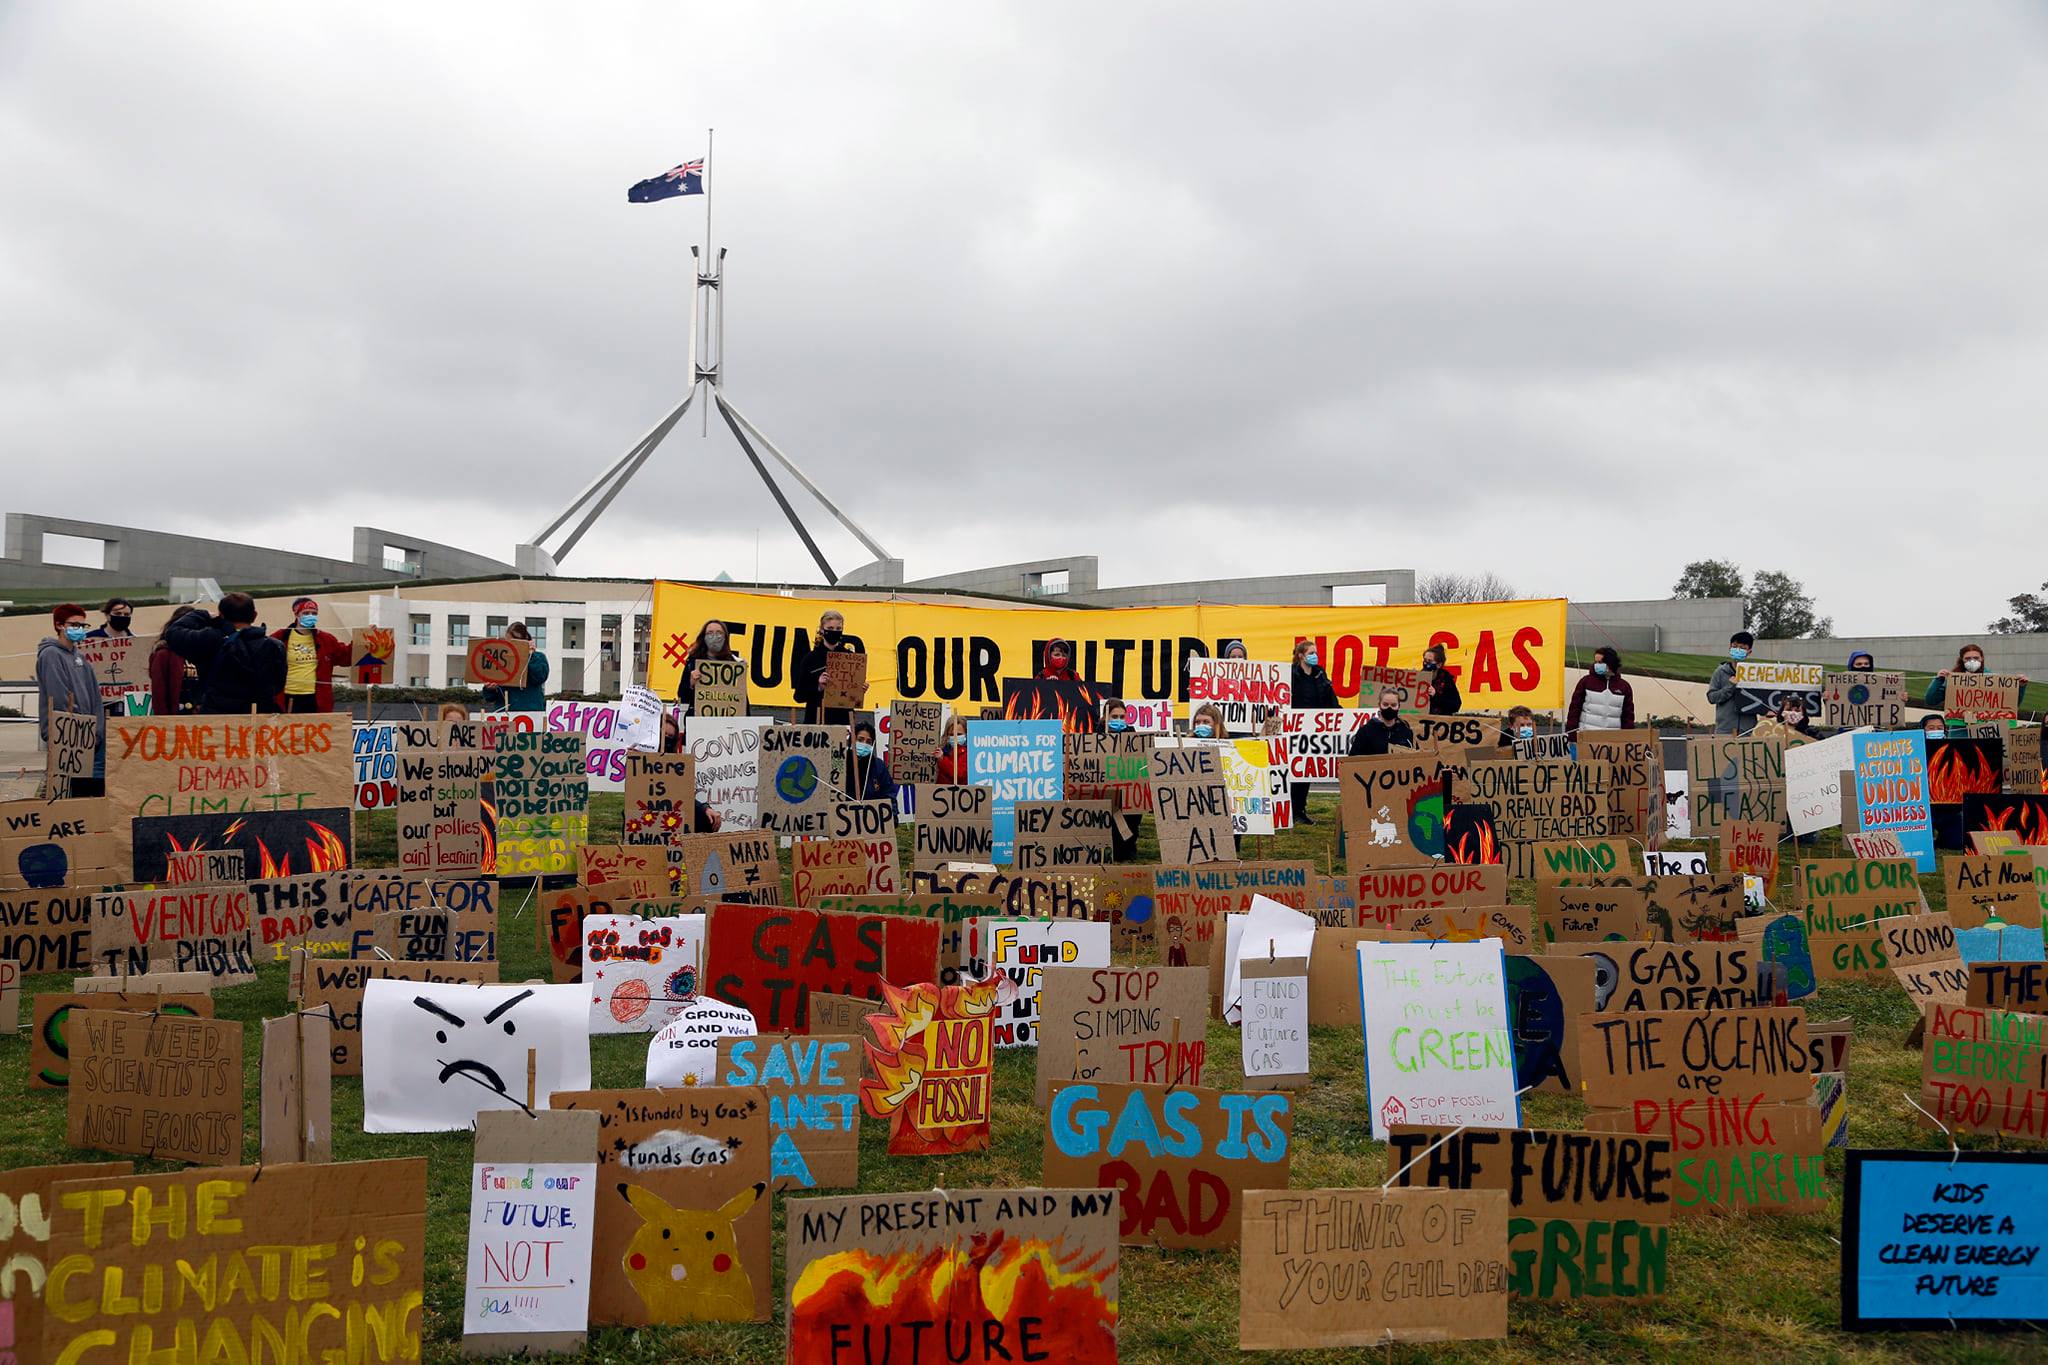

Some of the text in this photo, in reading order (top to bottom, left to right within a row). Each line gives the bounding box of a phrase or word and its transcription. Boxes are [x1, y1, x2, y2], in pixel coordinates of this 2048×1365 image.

[110, 651, 126, 661] OF
[481, 648, 507, 671] GAS
[699, 663, 744, 686] STOP
[897, 636, 1001, 703] OUR
[1200, 662, 1280, 681] AUSTRALIA IS
[1362, 665, 1416, 688] THERE
[1736, 665, 1822, 684] RENEWABLES
[1828, 674, 1899, 685] THERE IS NO
[1189, 677, 1291, 705] BURNING
[1951, 675, 2020, 688] THIS IS NOT
[698, 691, 740, 702] SELLING
[1956, 689, 2011, 709] NORMAL
[895, 703, 940, 719] We NEED
[1283, 712, 1348, 733] WE SEE
[1829, 704, 1899, 726] PLANET B
[400, 725, 437, 748] YOU
[449, 725, 476, 748] ARE
[905, 719, 934, 731] MORE
[1416, 719, 1482, 745] JOBS
[118, 725, 217, 762] YOUNG
[763, 728, 830, 751] SAVE OUR
[893, 730, 935, 749] People
[973, 734, 1057, 747] UNIONISTS FOR
[1549, 736, 1571, 756] OUR
[1866, 739, 1913, 758] CLIMATE
[58, 749, 83, 776] GAS
[403, 756, 479, 781] We should
[628, 755, 685, 776] There
[893, 764, 935, 782] Earth!
[974, 750, 1055, 774] CLIMATE
[1155, 751, 1213, 776] SAVE
[1860, 759, 1902, 778] ACTION
[1910, 758, 1922, 775] IS
[178, 765, 268, 793] DEMAND
[649, 779, 666, 796] is
[1355, 766, 1426, 808] YOUR
[1471, 766, 1529, 798] SOME
[1534, 765, 1558, 793] OF
[2011, 768, 2040, 785] HOTTER
[401, 781, 477, 802] be at school
[1820, 783, 1838, 797] NO
[1863, 777, 1921, 805] UNION
[433, 803, 456, 818] but
[932, 786, 986, 818] STOP
[1158, 785, 1228, 819] PLANET
[1507, 795, 1597, 819] REALLY BAD
[1802, 804, 1824, 818] NO
[7, 813, 86, 840] WE ARE
[762, 812, 827, 832] PLANET
[836, 803, 892, 836] STOP
[1018, 807, 1112, 832] HEY SCOMO
[1864, 805, 1927, 825] BUSINESS
[402, 823, 430, 840] our
[435, 820, 480, 842] pollies
[917, 824, 993, 854] FUNDING
[1534, 816, 1607, 839] TEACHERS
[1732, 826, 1764, 844] IF WE
[584, 849, 647, 870] You're
[729, 841, 770, 865] MARS
[1053, 844, 1112, 865] NOT YOUR
[1735, 844, 1772, 869] BURN
[1854, 837, 1897, 859] FUND
[1155, 869, 1191, 888] WHEN
[1196, 871, 1234, 891] WILL
[1235, 871, 1259, 888] YOU
[1262, 868, 1306, 888] LEARN
[1359, 870, 1486, 900] FUND OUR
[97, 896, 124, 918] TO
[1156, 893, 1190, 917] THAT
[1191, 893, 1231, 917] YOUR
[1560, 897, 1618, 912] Save our
[1563, 917, 1599, 932] Future!
[752, 915, 882, 974] GAS
[1888, 924, 1955, 958] SCOMO
[317, 966, 371, 990] We'll
[1630, 948, 1748, 986] GAS IS
[1088, 970, 1159, 1004] STOP
[1254, 981, 1300, 999] FUND
[1931, 968, 1971, 993] TOO
[685, 1010, 752, 1021] GROUND
[1476, 998, 1497, 1018] be
[1073, 1008, 1162, 1041] SIMPING
[1932, 1005, 1986, 1039] ACT
[85, 1017, 220, 1058] WE NEED
[655, 1025, 723, 1044] SUN AND
[669, 1040, 684, 1049] IS
[936, 1020, 984, 1069] NO
[1593, 1015, 1808, 1074] THE OCEANS
[727, 1041, 851, 1087] SAVE
[1251, 1050, 1282, 1072] GAS
[1933, 1040, 2031, 1083] BEFORE
[84, 1056, 231, 1097] SCIENTISTS
[1678, 1073, 1723, 1095] are
[920, 1075, 985, 1124] FOSSIL
[1386, 1105, 1400, 1116] NO
[1410, 1095, 1498, 1111] STOP FOSSIL
[1930, 1081, 1992, 1127] TOO
[82, 1104, 132, 1145] NOT
[641, 1105, 709, 1126] funded by
[1050, 1085, 1290, 1164] GAS IS
[1420, 1113, 1463, 1126] FUELS
[481, 1167, 581, 1190] Fund our
[1511, 1131, 1671, 1207] FUTURE
[1676, 1157, 1721, 1207] SO
[1933, 1183, 1988, 1204] KIDS
[60, 1180, 247, 1248] THE
[802, 1191, 1114, 1244] MY PRESENT AND MY
[1903, 1213, 2014, 1236] DESERVE A
[1264, 1196, 1476, 1256] THINK OF
[484, 1241, 564, 1283] NOT
[1508, 1218, 1669, 1300] GREEN
[1879, 1245, 2040, 1267] CLEAN ENERGY
[45, 1242, 337, 1323] CLIMATE
[1279, 1258, 1508, 1310] YOUR CHILDREN
[1915, 1275, 1999, 1297] FUTURE
